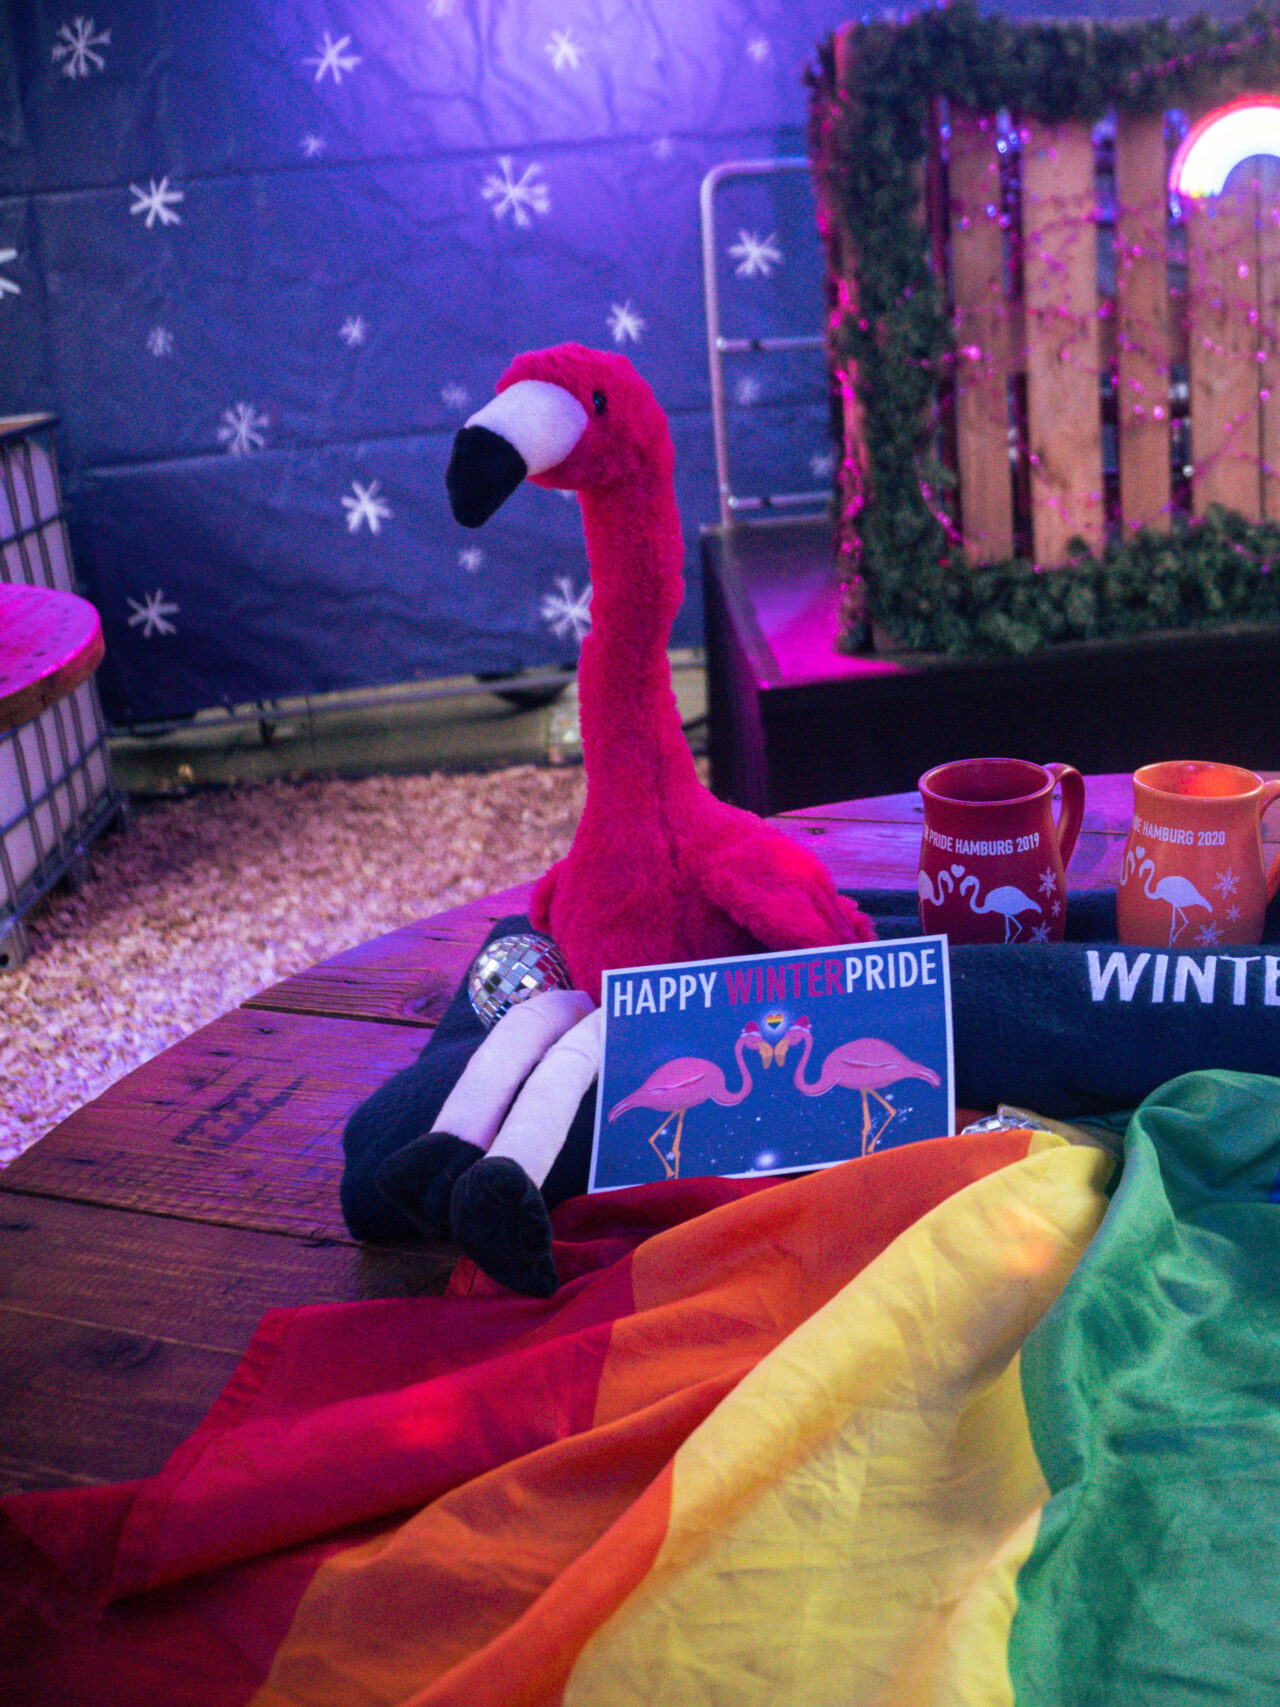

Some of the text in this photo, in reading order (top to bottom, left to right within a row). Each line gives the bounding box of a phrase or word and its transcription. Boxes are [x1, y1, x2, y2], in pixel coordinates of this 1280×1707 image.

[929, 829, 953, 852] PRIDE
[955, 838, 1014, 857] HAMBURG
[1016, 832, 1040, 853] 2019
[1142, 821, 1194, 845] HAMBURG
[1197, 831, 1226, 846] 2020
[613, 948, 937, 1018] HAPPY WINTERPRIDE
